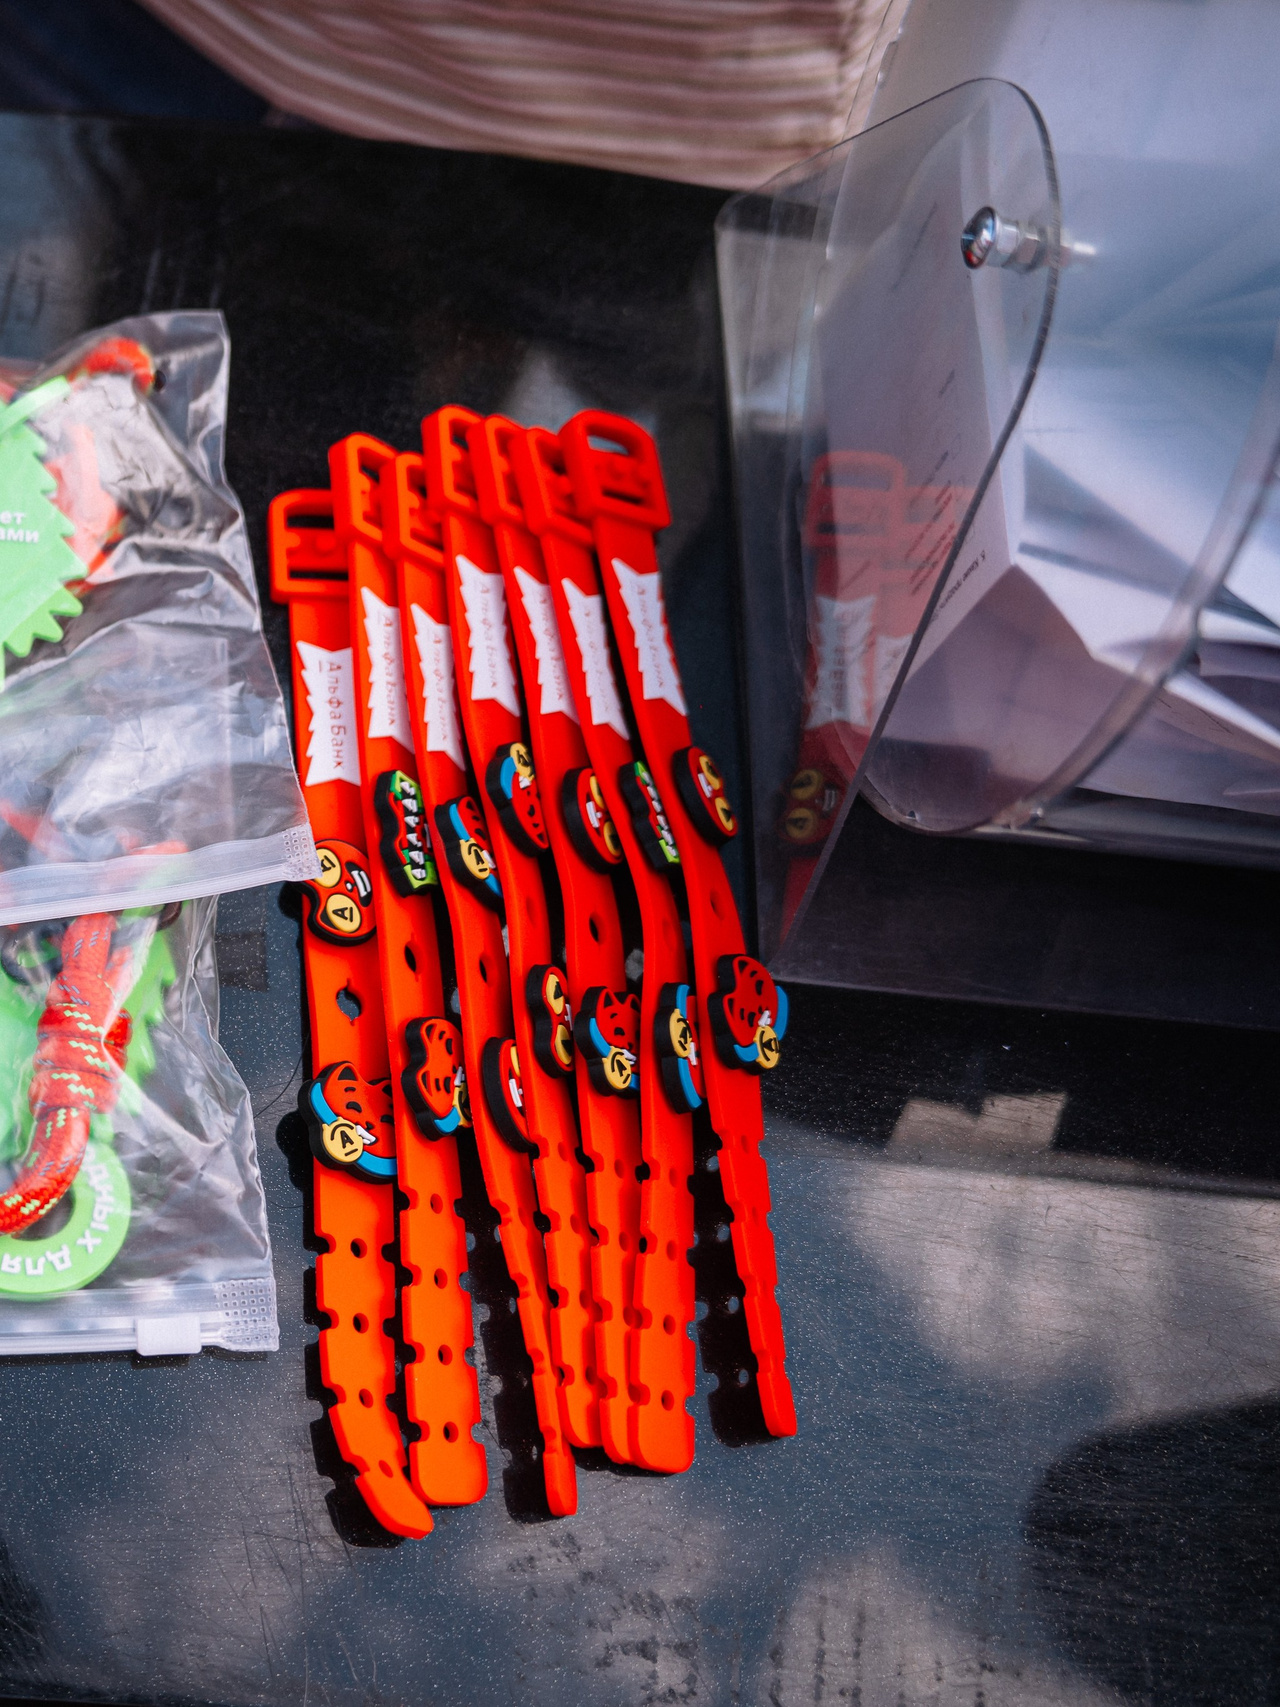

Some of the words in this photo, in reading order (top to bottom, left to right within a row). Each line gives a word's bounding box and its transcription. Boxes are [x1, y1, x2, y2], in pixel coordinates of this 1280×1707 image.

[324, 661, 343, 720] Альфа
[331, 725, 346, 770] Банк
[0, 1243, 72, 1276] для
